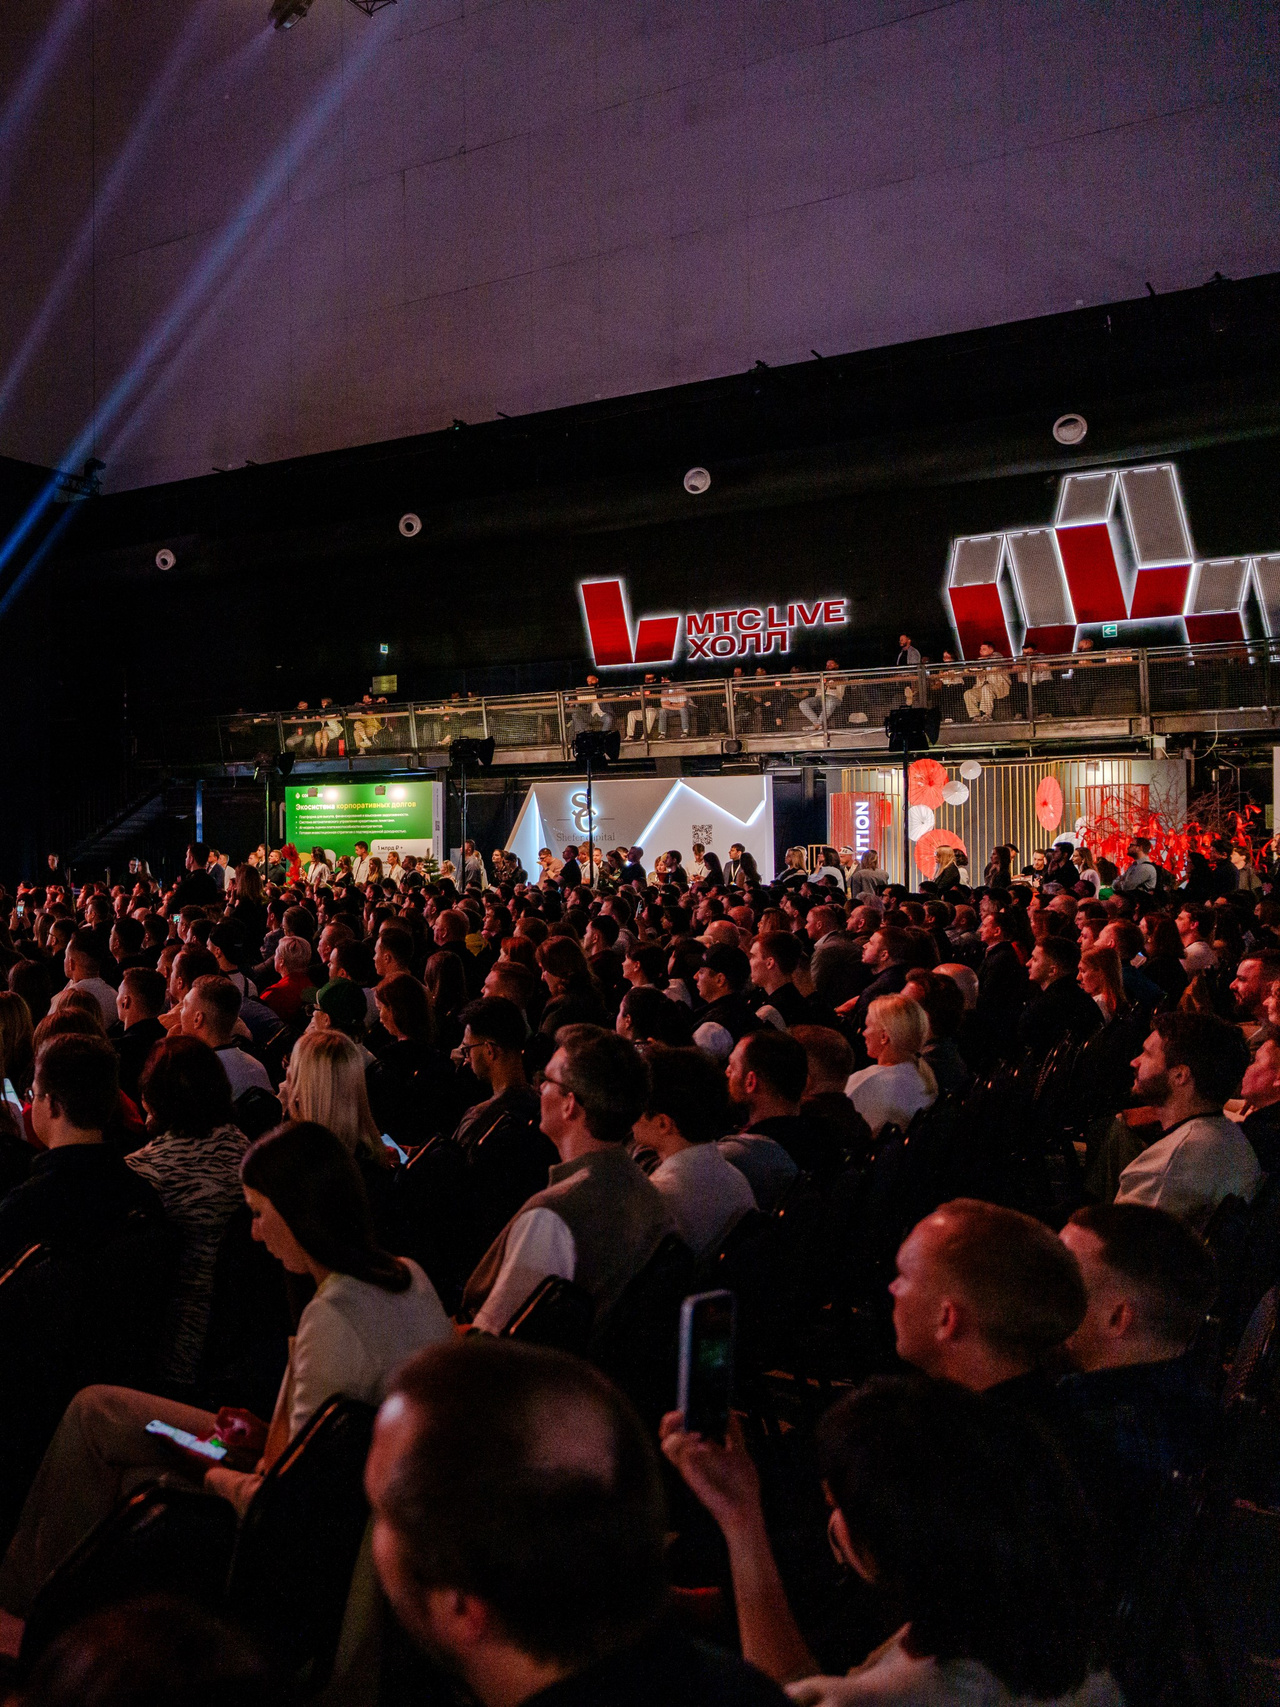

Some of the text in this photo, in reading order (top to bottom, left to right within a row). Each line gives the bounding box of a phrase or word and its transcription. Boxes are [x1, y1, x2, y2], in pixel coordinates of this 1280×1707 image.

[687, 600, 845, 636] МТС LIVE
[687, 630, 789, 660] ХОЛЛ
[295, 801, 417, 811] Экосистема корпоративных долгов
[556, 832, 616, 842] Shefer cpital
